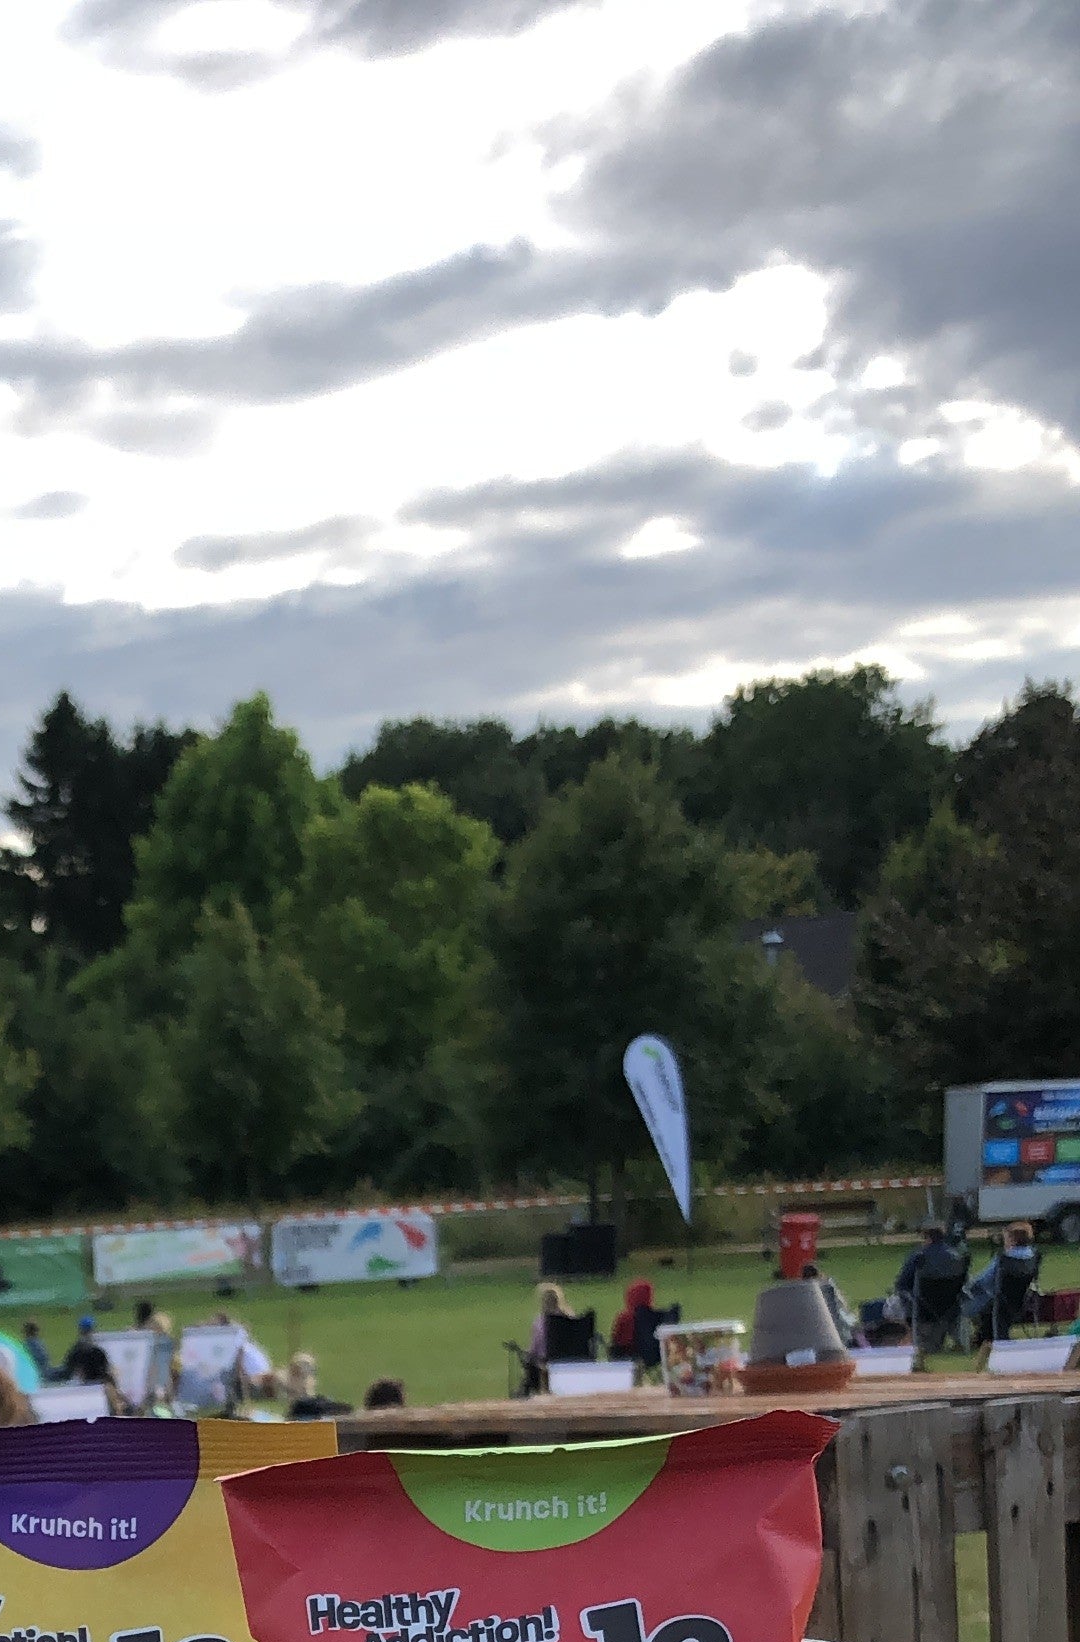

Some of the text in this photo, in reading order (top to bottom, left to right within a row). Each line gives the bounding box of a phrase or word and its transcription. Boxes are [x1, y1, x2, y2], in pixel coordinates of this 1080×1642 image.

[464, 1492, 608, 1522] Krunch it!
[11, 1513, 138, 1541] Krunch it!
[307, 1588, 460, 1636] Healthy
